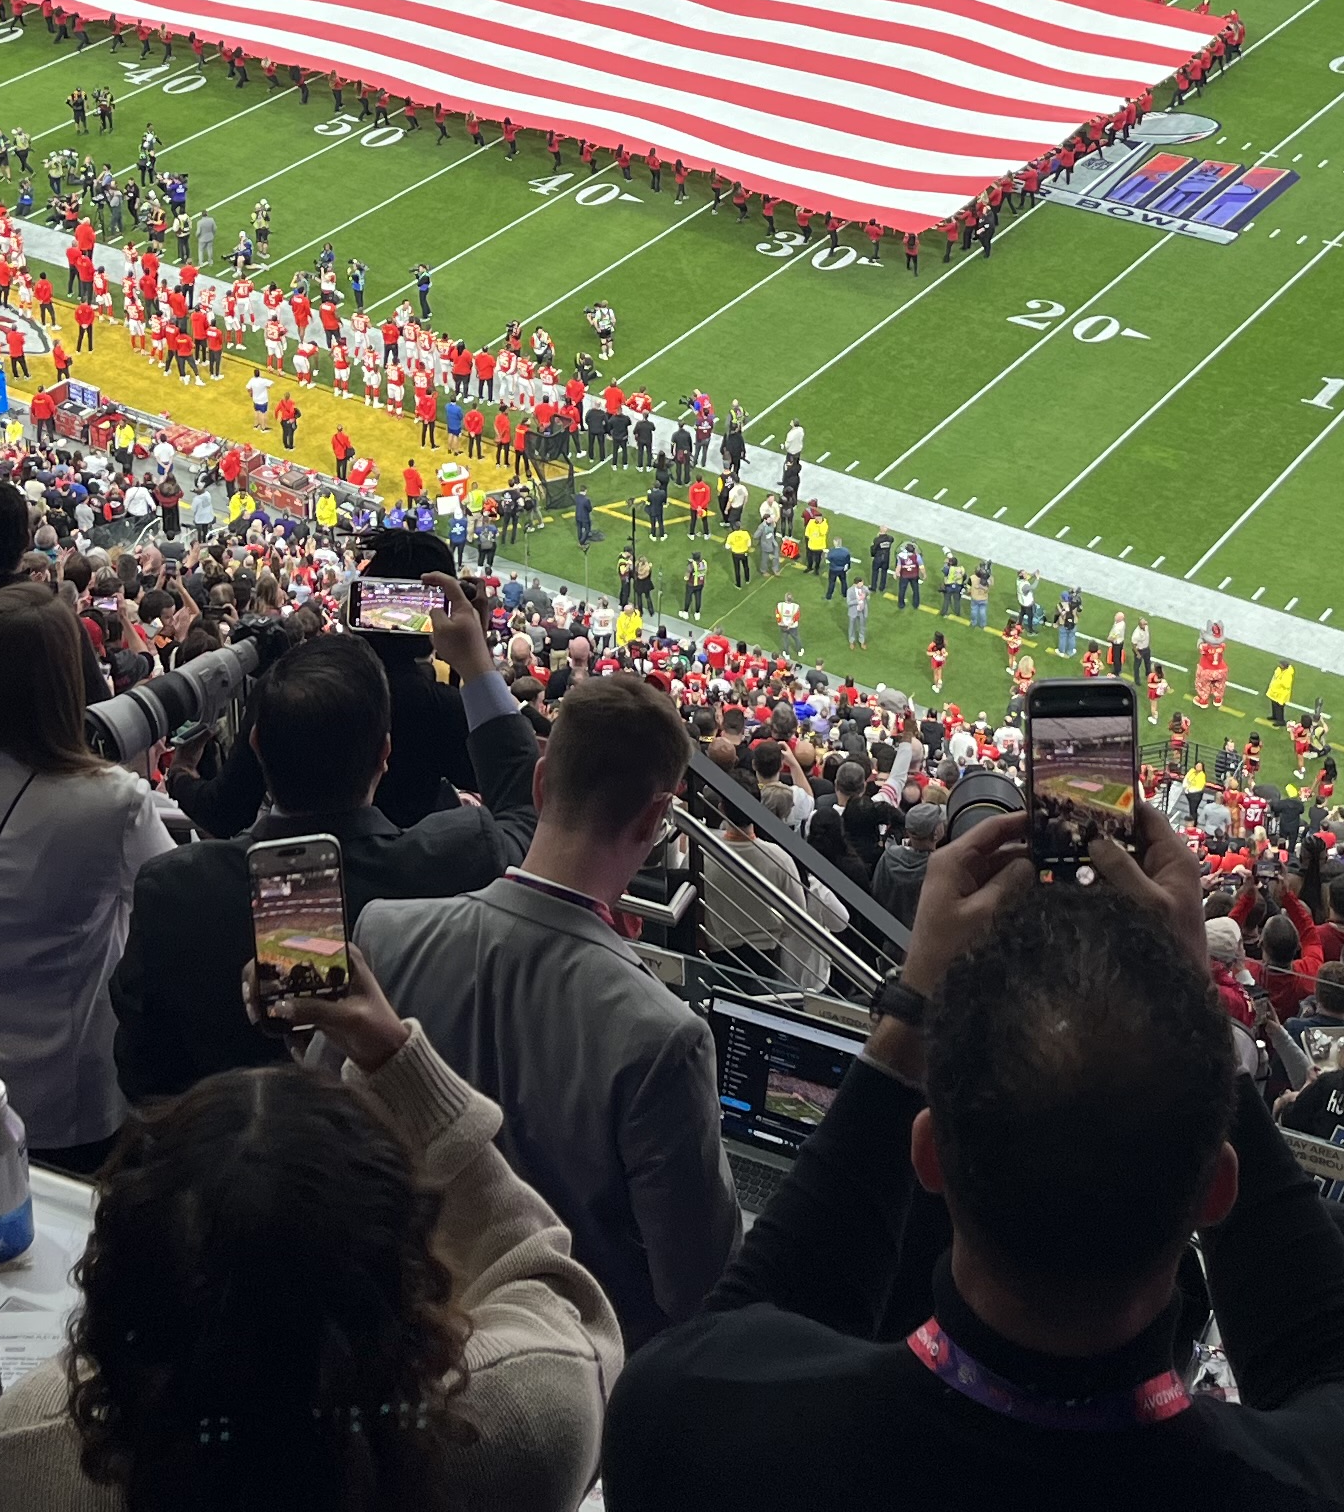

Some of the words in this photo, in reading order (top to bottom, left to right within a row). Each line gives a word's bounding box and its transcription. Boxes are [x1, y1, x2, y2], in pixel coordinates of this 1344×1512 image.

[124, 64, 207, 94] 40
[313, 113, 407, 147] 50
[528, 172, 621, 206] 40
[1075, 198, 1199, 235] BOWL
[756, 230, 857, 271] 30
[1006, 299, 1120, 343] 20
[1246, 808, 1263, 822] 97
[1310, 1143, 1341, 1161] AREA
